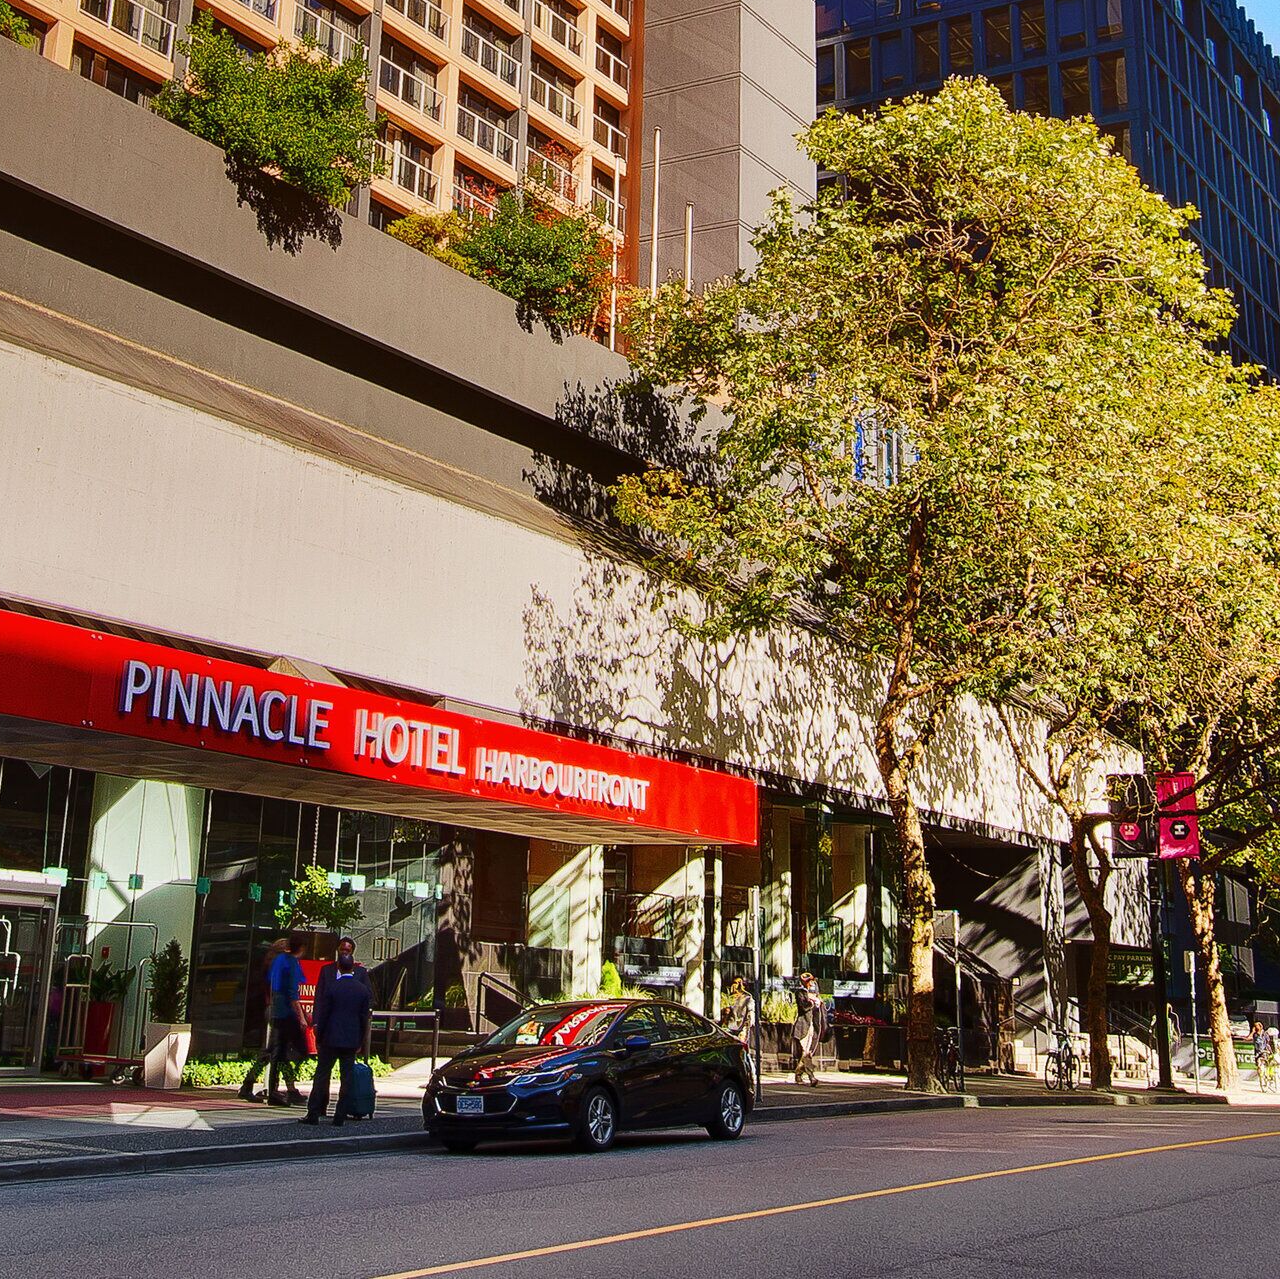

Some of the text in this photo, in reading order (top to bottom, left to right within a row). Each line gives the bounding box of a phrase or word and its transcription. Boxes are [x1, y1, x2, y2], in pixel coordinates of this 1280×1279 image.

[119, 659, 651, 811] PINNACLE HOTEL HARBOURFRONT
